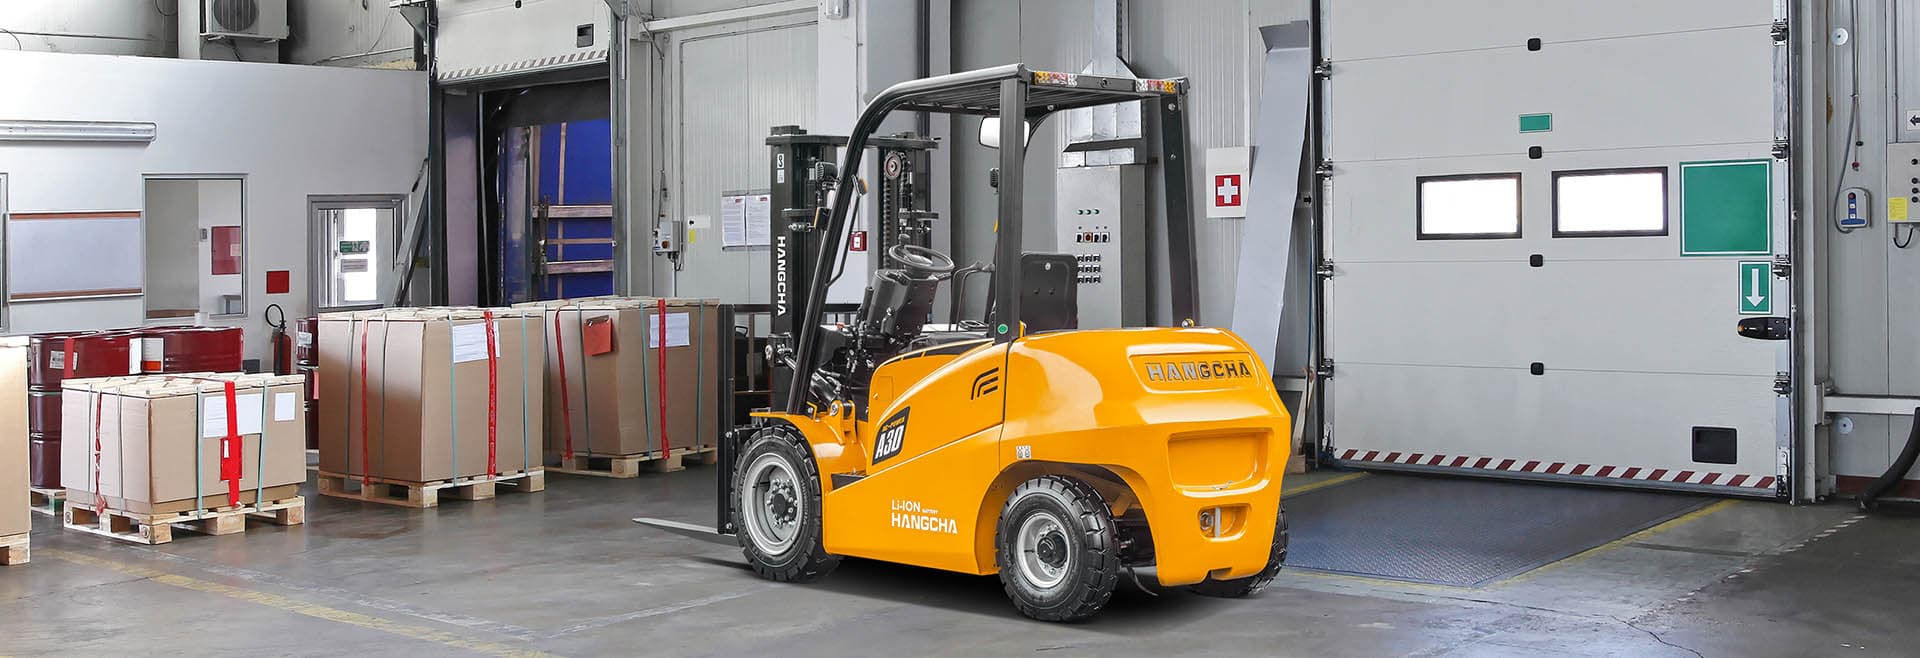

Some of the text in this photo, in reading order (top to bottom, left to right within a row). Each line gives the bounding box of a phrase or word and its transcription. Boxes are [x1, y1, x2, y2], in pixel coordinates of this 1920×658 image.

[777, 236, 786, 316] HANGCHA
[1144, 360, 1252, 381] HANGCHA
[874, 424, 905, 459] A30
[891, 512, 958, 535] HANGCHA
